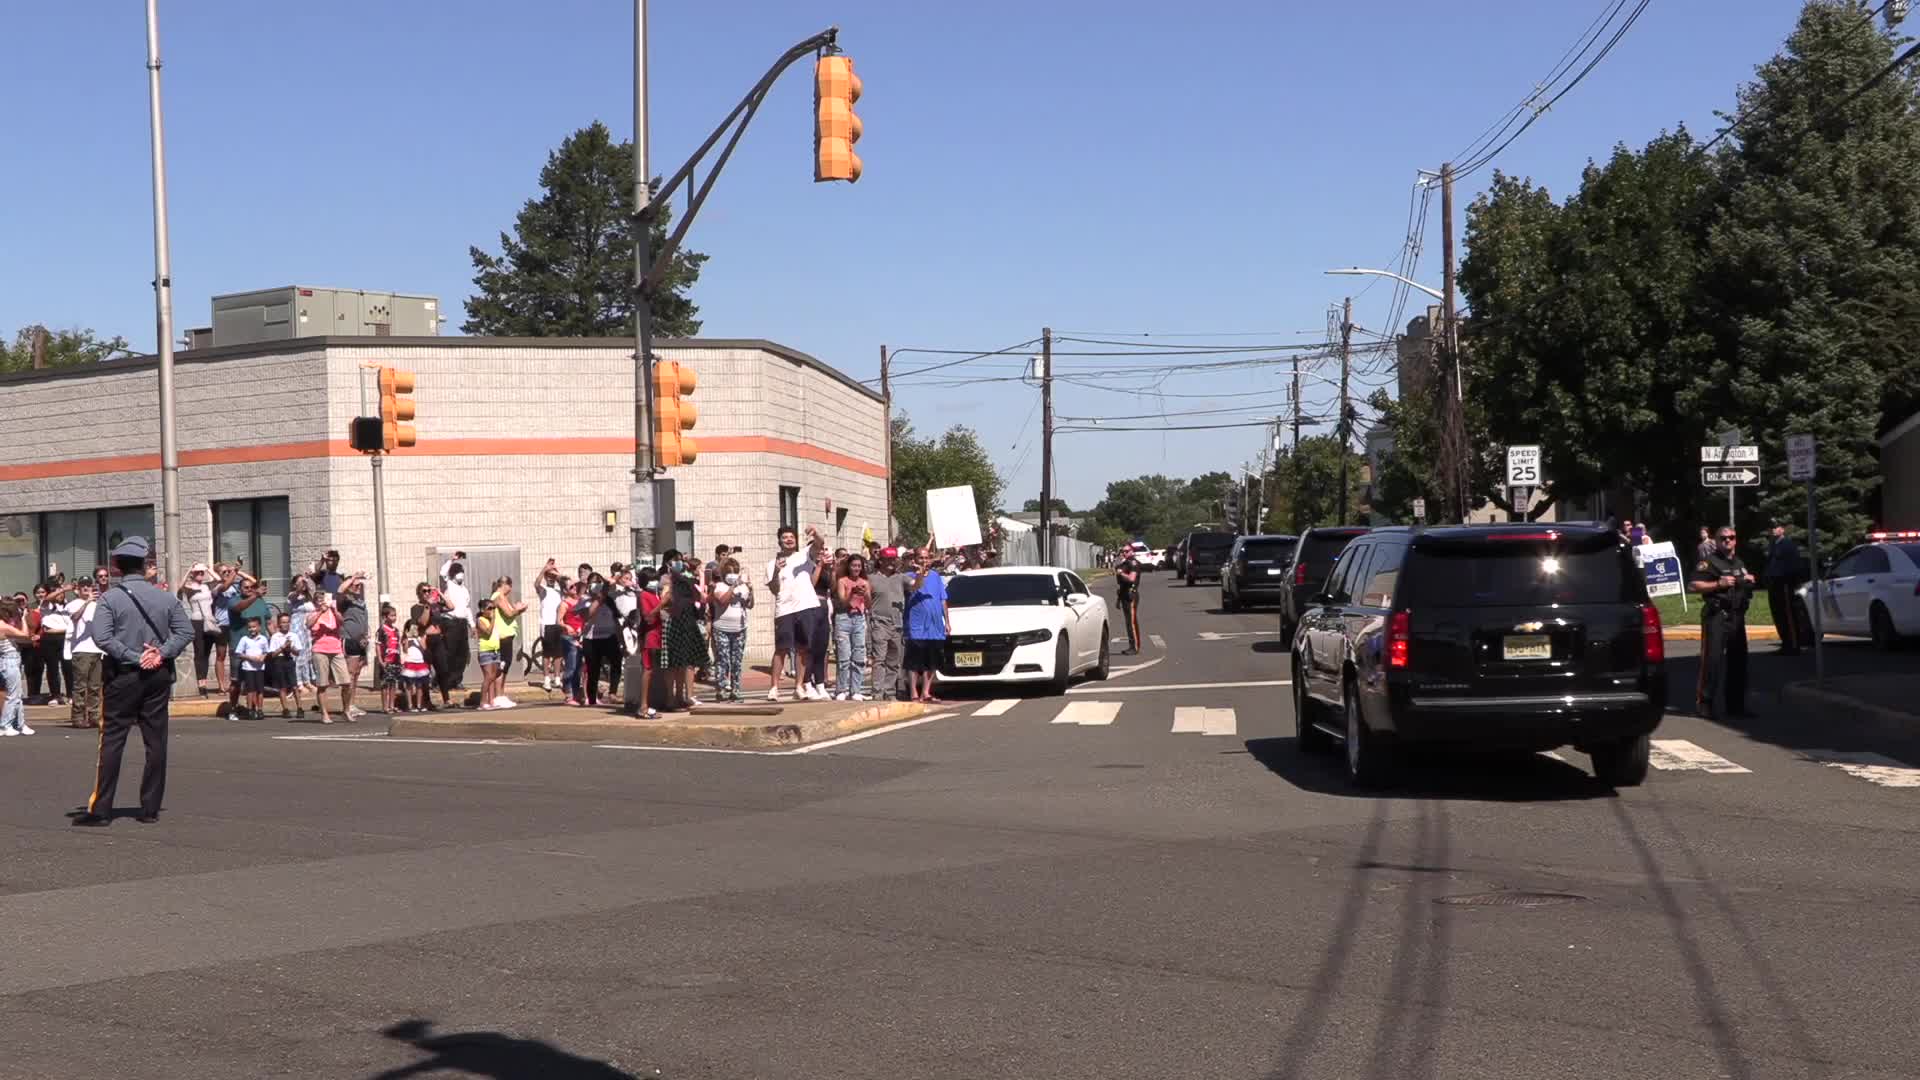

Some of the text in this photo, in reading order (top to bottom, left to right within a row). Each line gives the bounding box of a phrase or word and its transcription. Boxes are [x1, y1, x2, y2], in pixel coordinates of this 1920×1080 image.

[1510, 449, 1537, 457] SPEED
[1713, 447, 1746, 460] Arngton
[1511, 466, 1537, 481] 25
